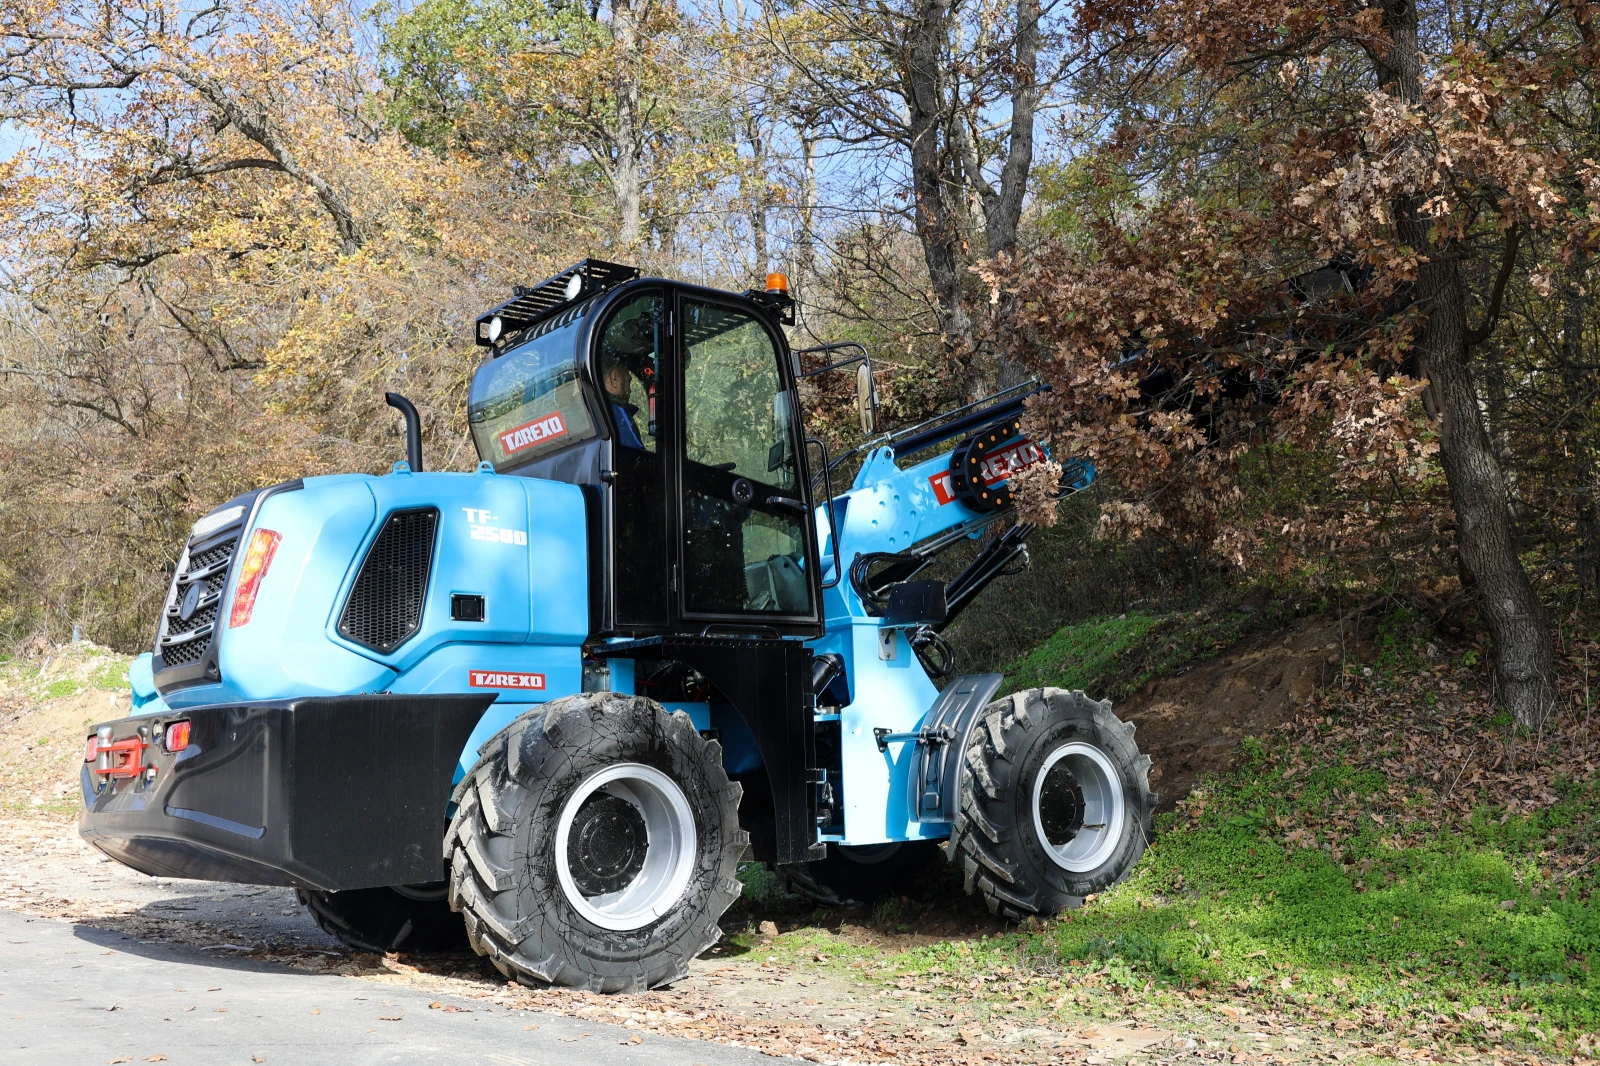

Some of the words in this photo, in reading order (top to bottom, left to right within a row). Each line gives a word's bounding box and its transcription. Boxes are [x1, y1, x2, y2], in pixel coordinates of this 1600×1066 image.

[502, 416, 564, 451] TAREXO
[934, 442, 1040, 499] TREXO
[462, 507, 499, 524] TF-
[470, 524, 528, 546] 2500
[472, 672, 543, 687] TAREXO
